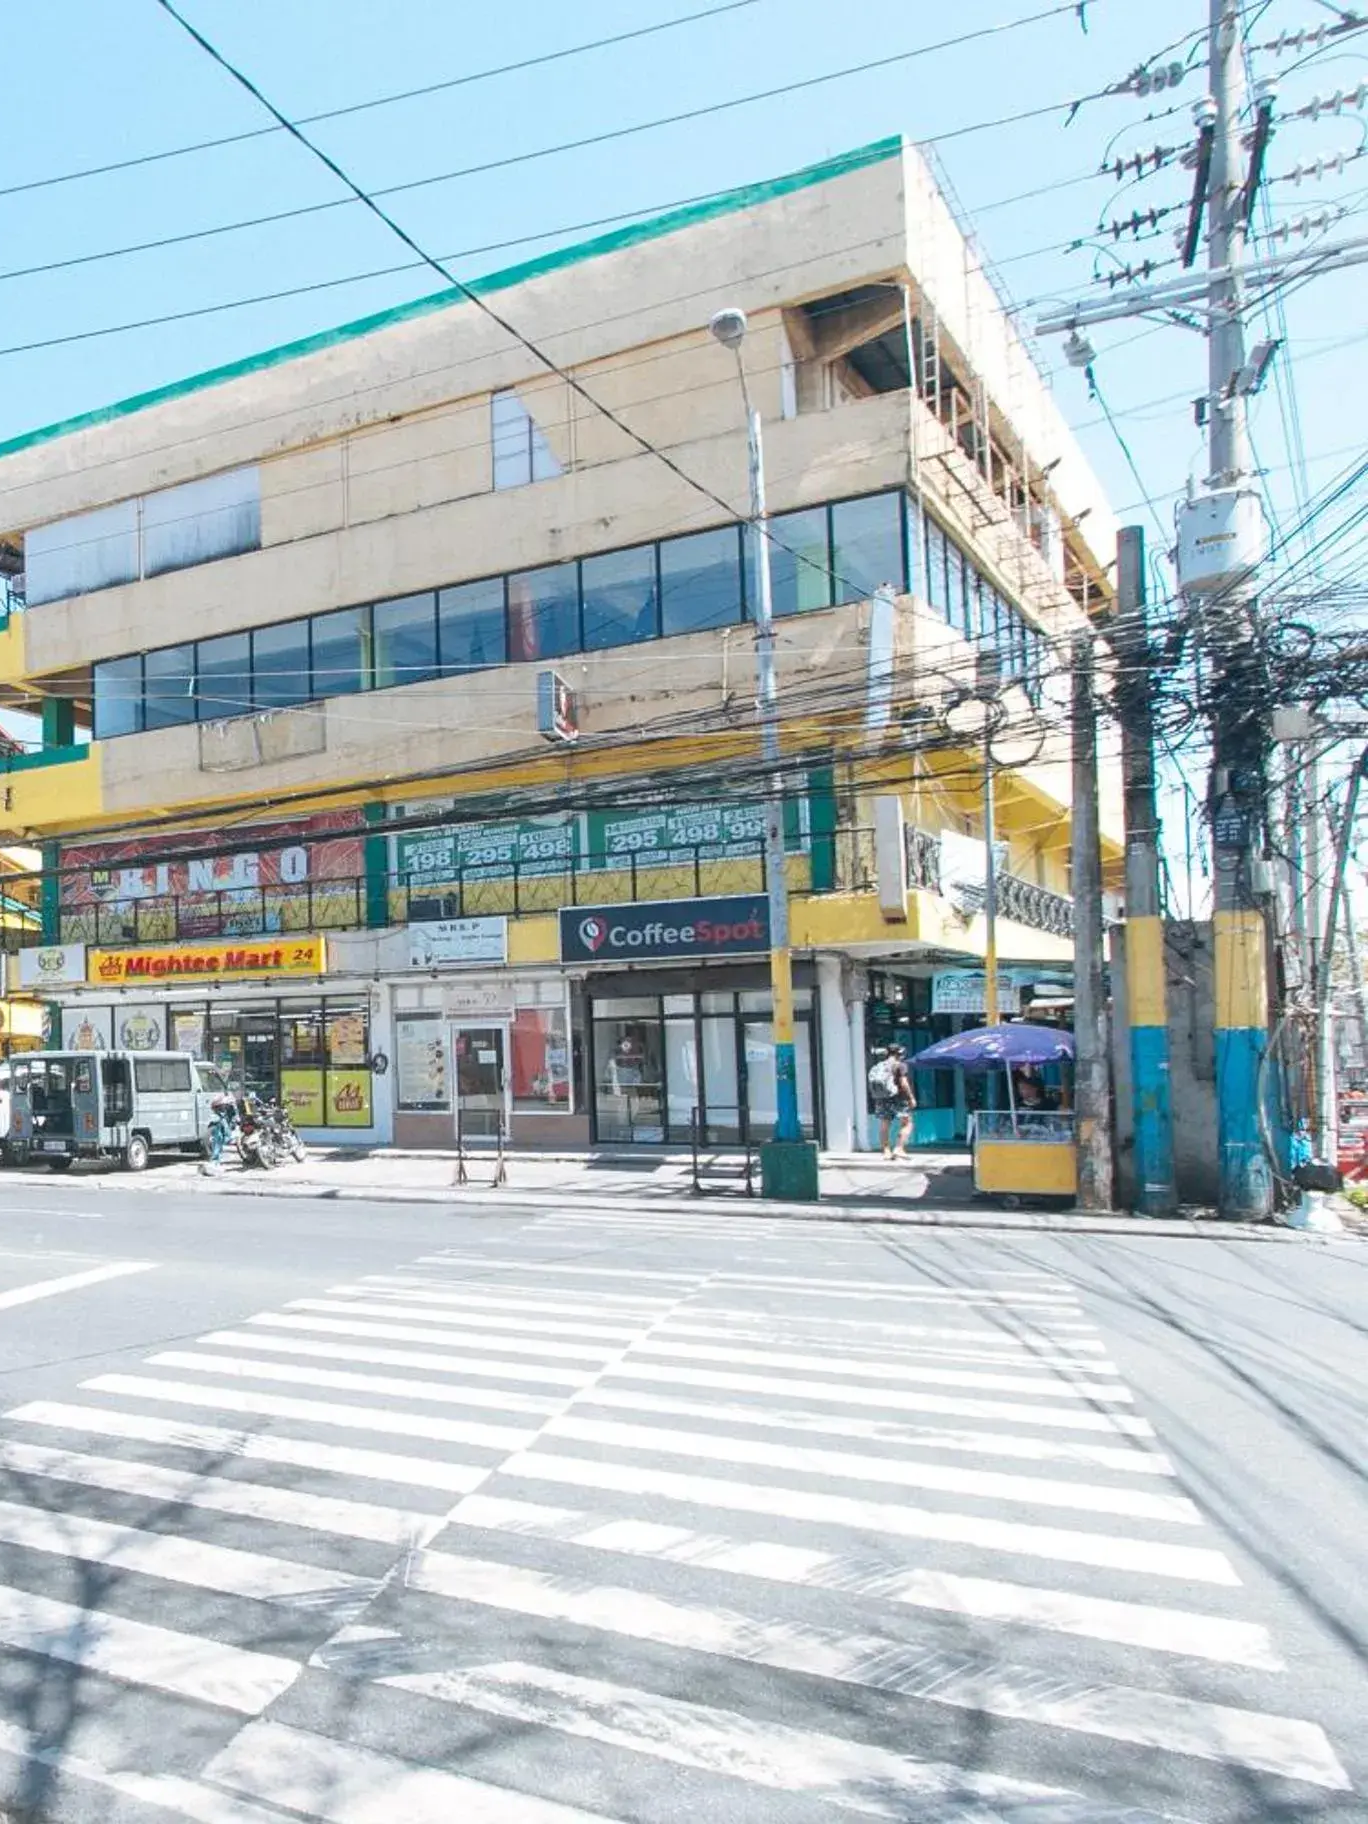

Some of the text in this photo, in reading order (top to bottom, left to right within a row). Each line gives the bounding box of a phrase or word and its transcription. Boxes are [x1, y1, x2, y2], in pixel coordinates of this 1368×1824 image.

[611, 829, 659, 852] 295
[672, 823, 719, 845] 498
[407, 850, 452, 871] 198
[465, 847, 512, 866] 295
[608, 919, 764, 947] CoffeeSpot
[125, 954, 220, 978] Mightee
[224, 949, 284, 970] Mart
[292, 948, 314, 961] 24
